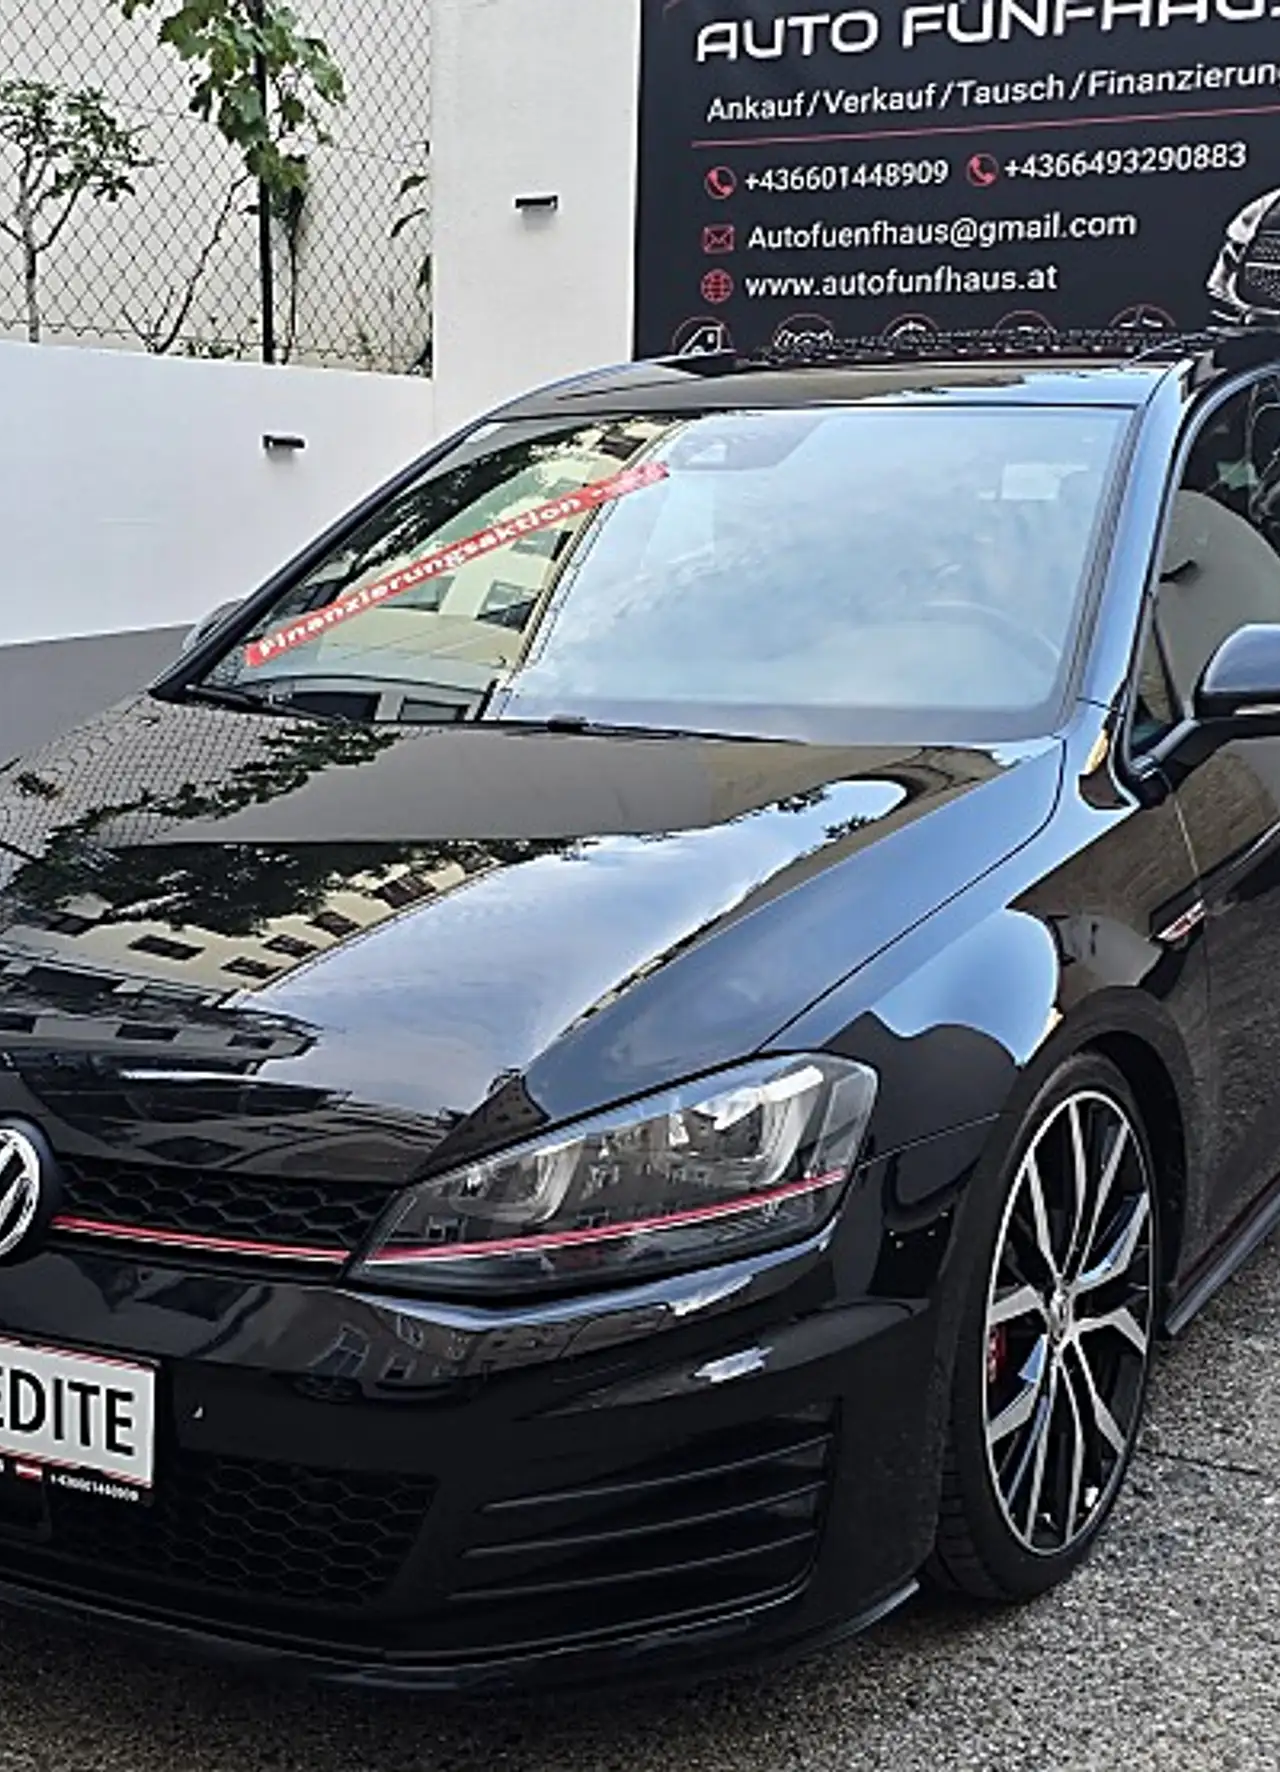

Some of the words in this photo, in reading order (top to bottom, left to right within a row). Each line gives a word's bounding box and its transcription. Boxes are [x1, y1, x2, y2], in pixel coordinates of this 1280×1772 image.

[695, 10, 880, 63] AUTO
[745, 159, 949, 192] +436601448909
[1004, 141, 1247, 178] +4366493290883
[747, 211, 1138, 249] Autofuenfhaus@gmail.com
[745, 264, 1058, 297] www.autofunfhaus.at
